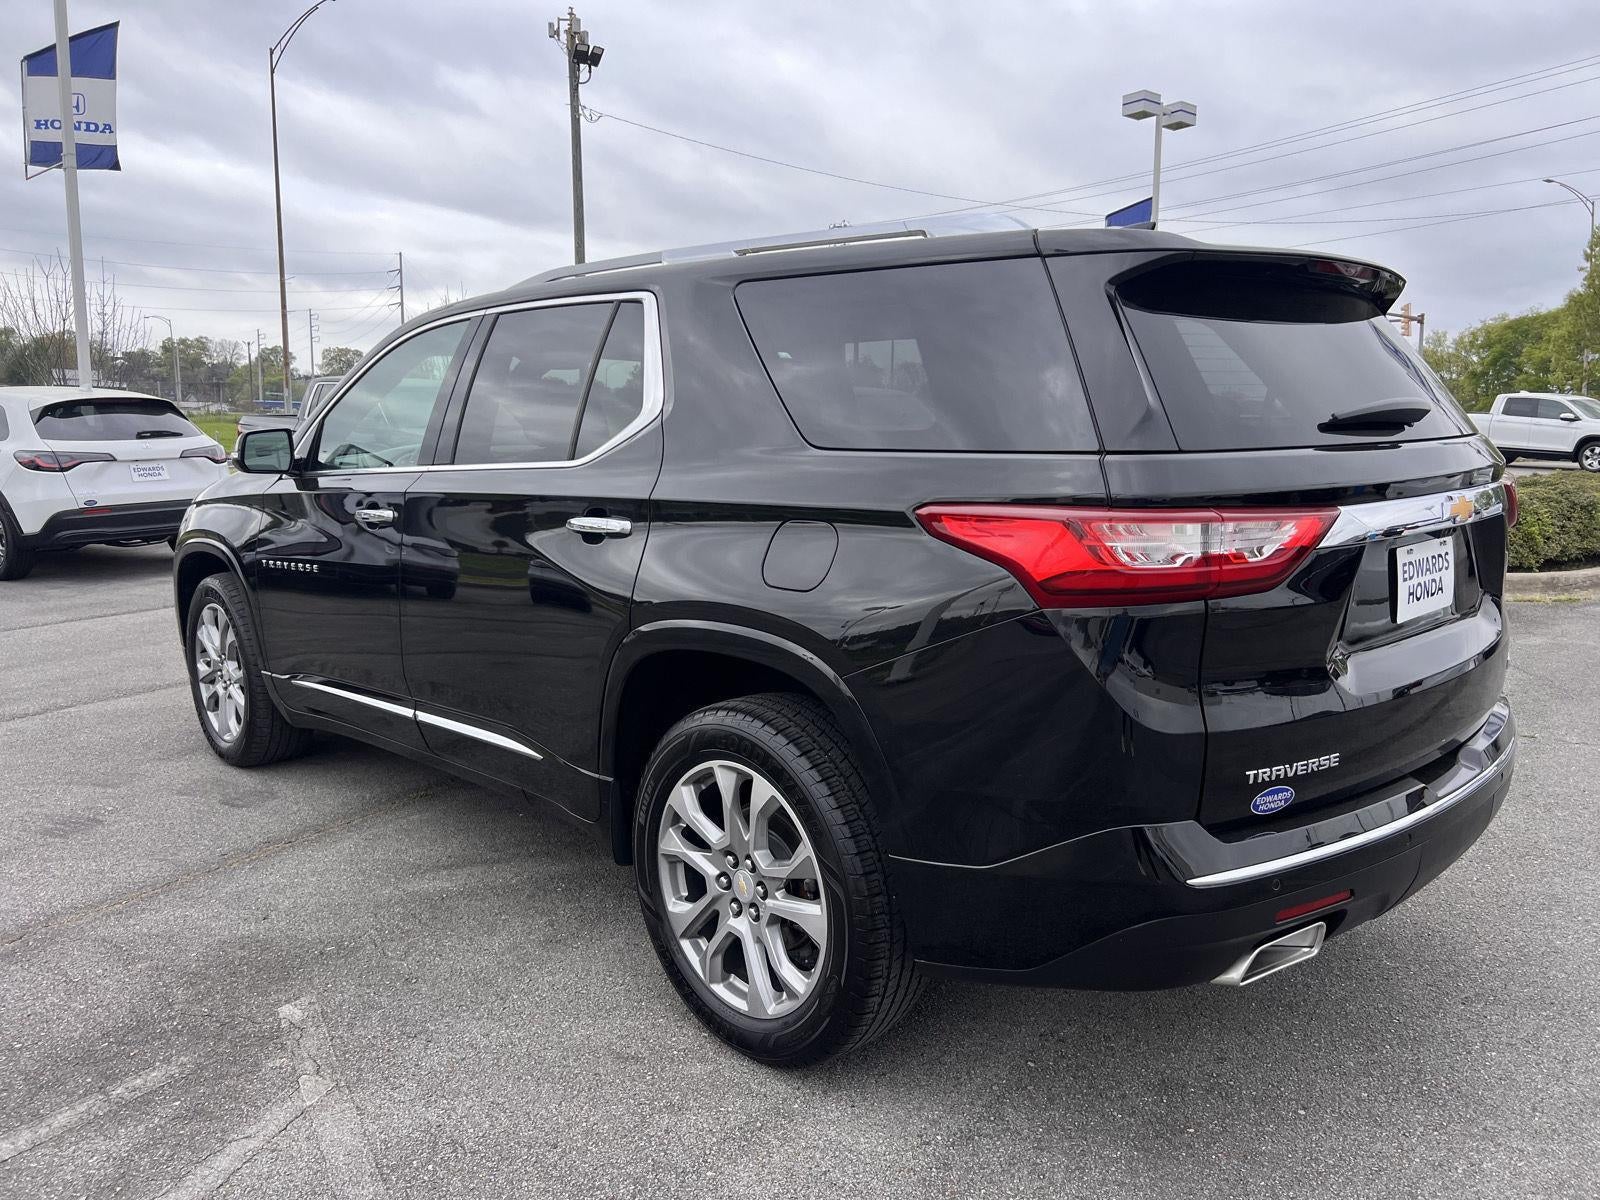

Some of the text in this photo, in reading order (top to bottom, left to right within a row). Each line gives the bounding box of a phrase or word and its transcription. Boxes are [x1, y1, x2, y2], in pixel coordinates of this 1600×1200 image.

[132, 465, 165, 473] EDWARDS
[261, 559, 320, 573] TRAVERSE
[1402, 551, 1450, 583] EDWARDS
[1407, 576, 1444, 605] HONDA
[1245, 753, 1340, 785] TRAVERSE
[1256, 791, 1292, 805] EDWARDS
[1258, 800, 1285, 812] HONDA
